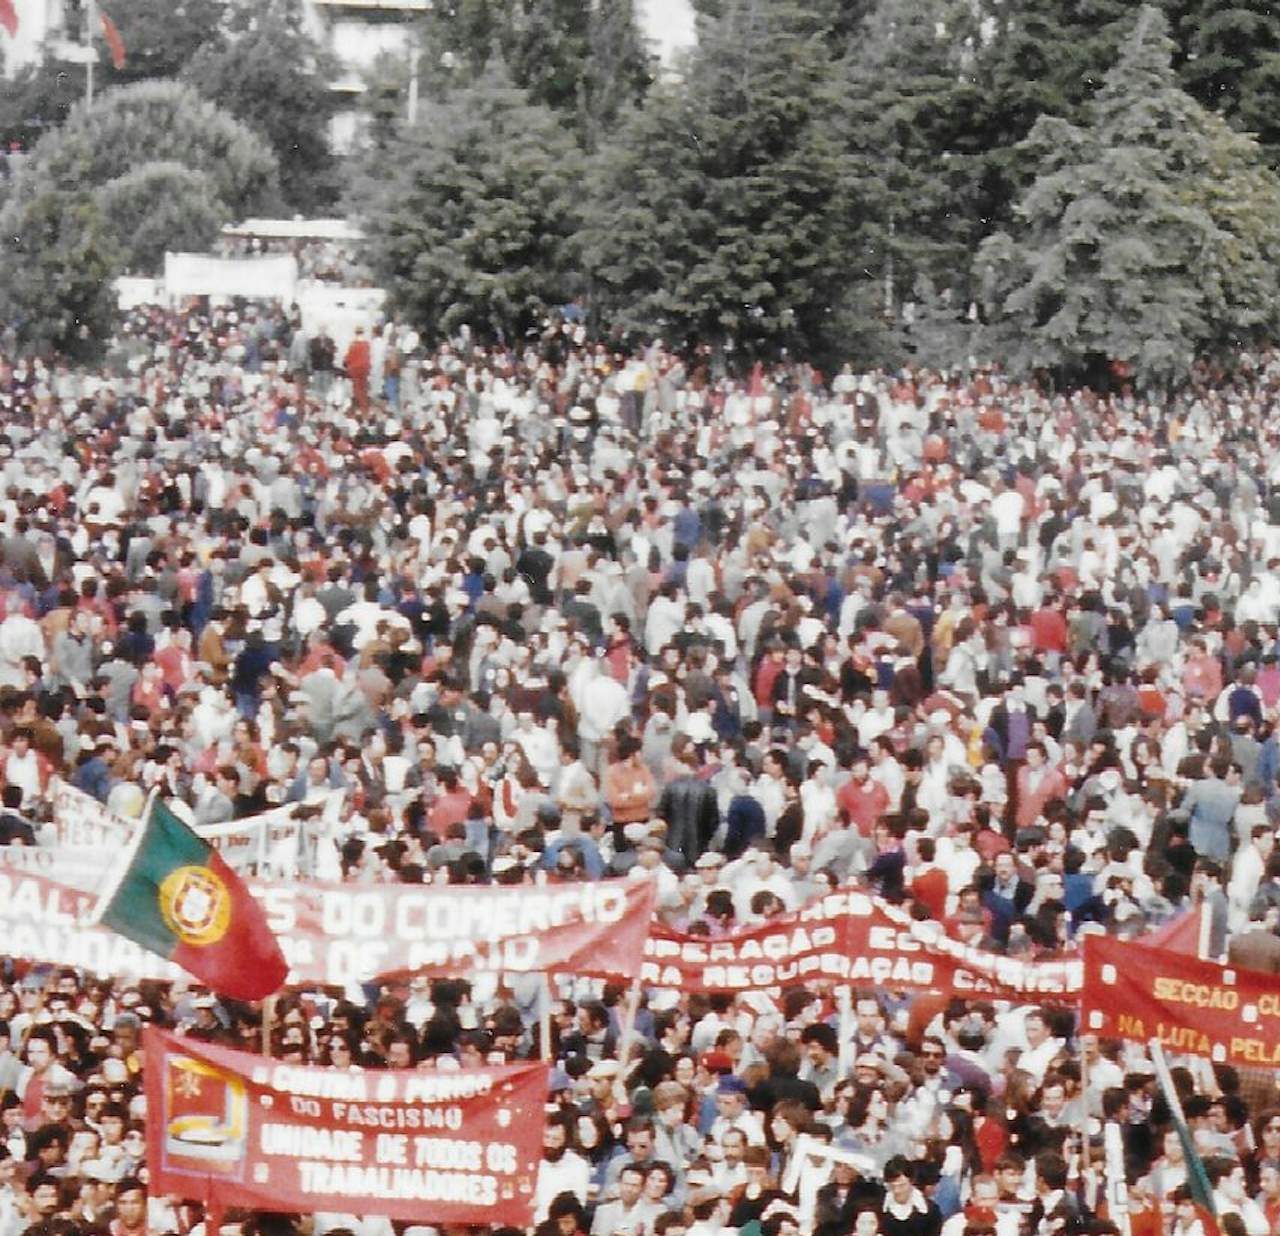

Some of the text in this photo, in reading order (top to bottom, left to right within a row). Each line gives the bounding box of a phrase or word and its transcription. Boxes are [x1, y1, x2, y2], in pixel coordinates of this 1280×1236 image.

[322, 890, 385, 936] DO
[1118, 1014, 1145, 1038] NA
[1156, 1022, 1210, 1053] LUTA
[291, 1097, 463, 1129] DO FASCISMO
[260, 1124, 518, 1176] UNIDADE DE TODOS OS
[299, 1163, 498, 1206] TRABALHADORES
